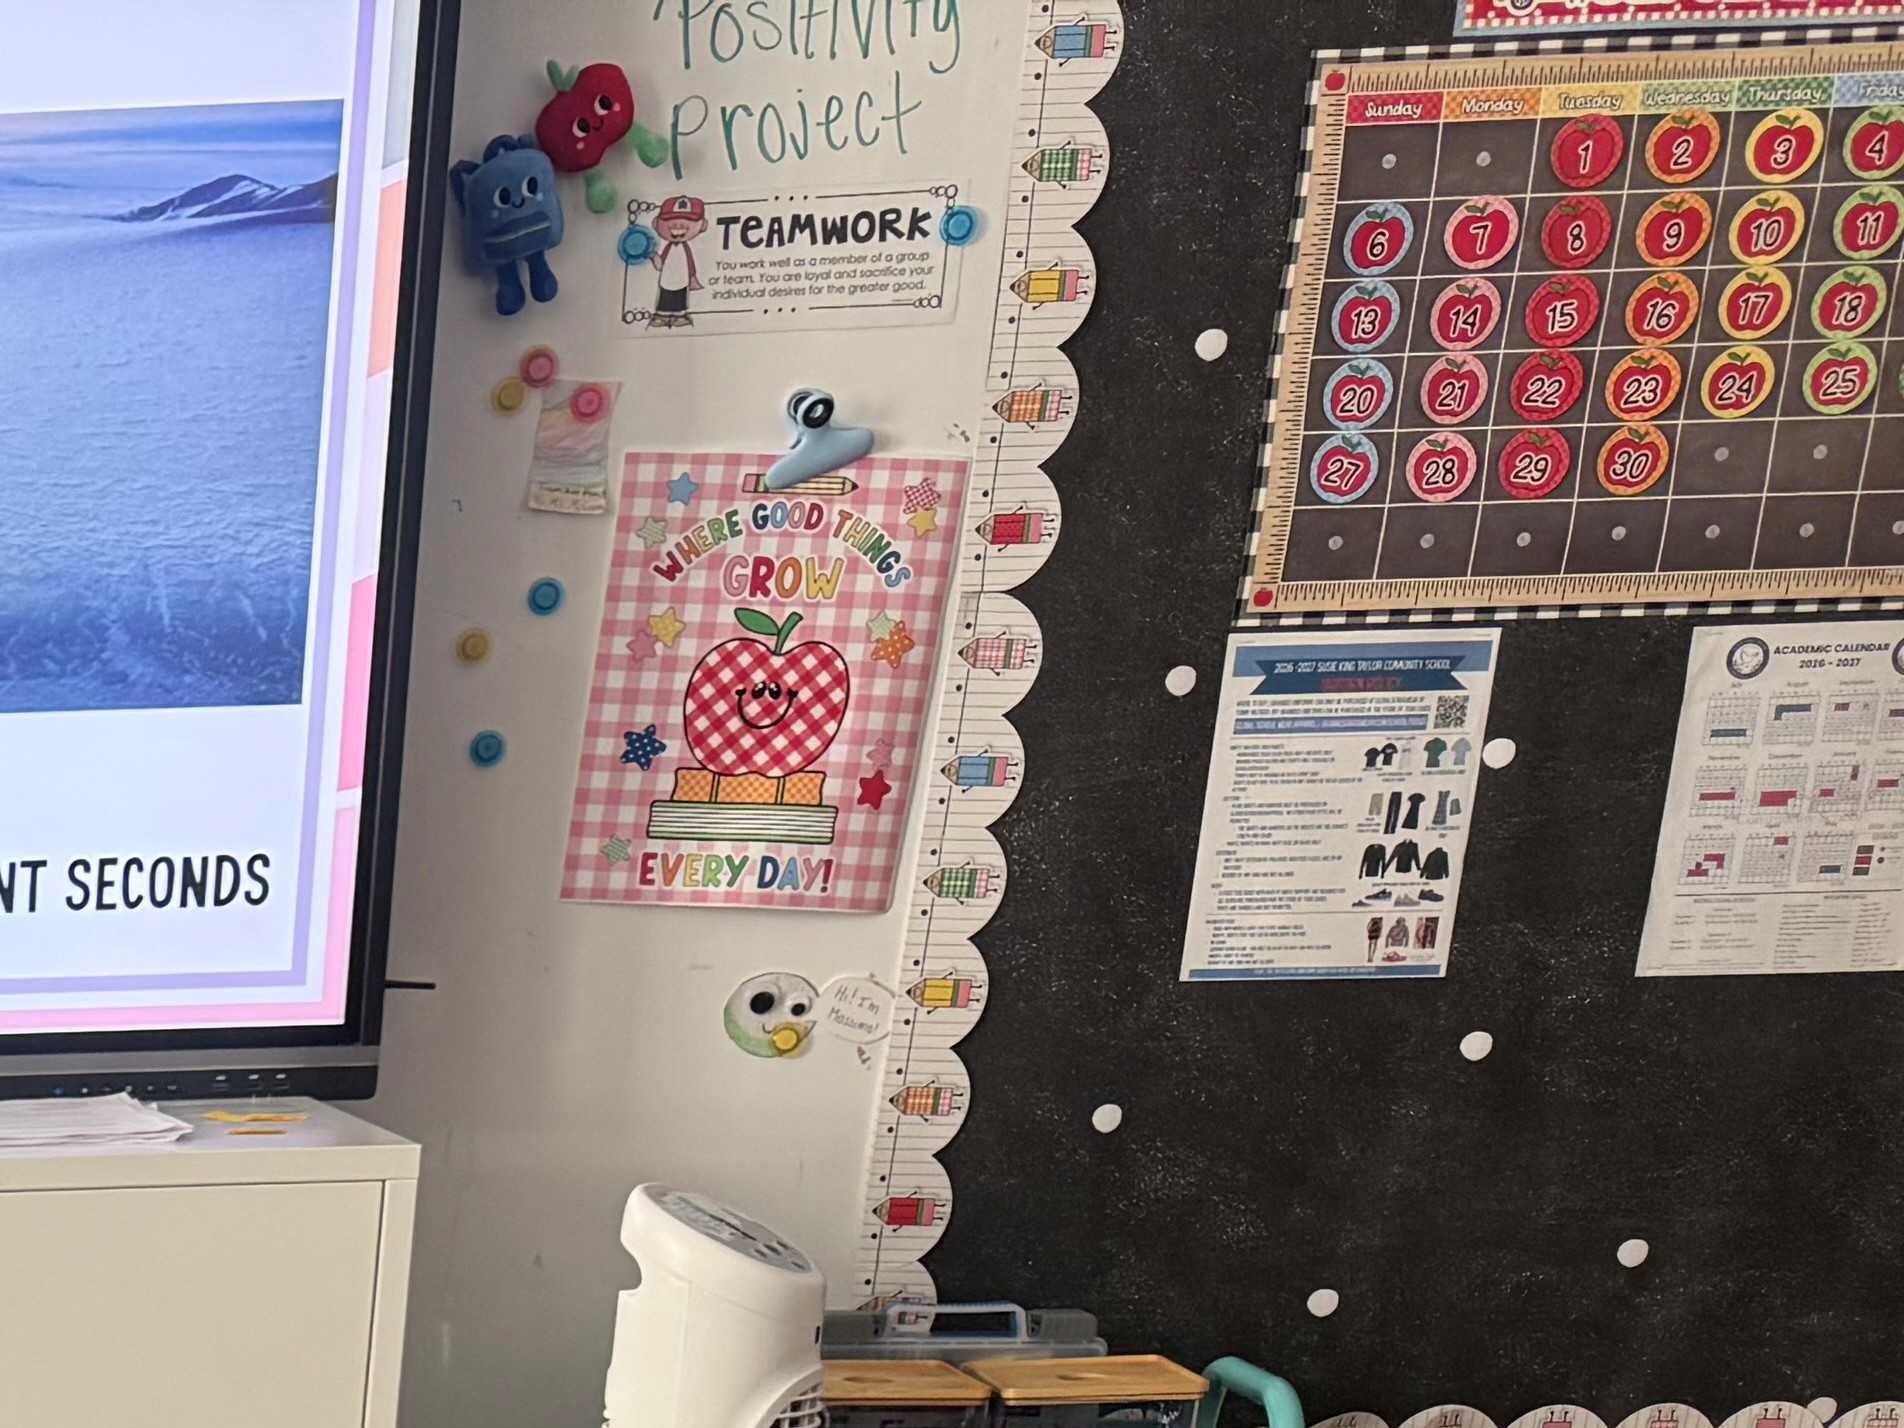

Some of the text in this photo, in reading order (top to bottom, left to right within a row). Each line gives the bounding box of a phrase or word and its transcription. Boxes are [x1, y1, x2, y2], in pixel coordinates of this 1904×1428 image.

[1365, 101, 1423, 123] Sunday
[1462, 97, 1525, 115] Monday
[1558, 92, 1623, 109] Tuesday
[1644, 88, 1731, 106] Wednesday
[1748, 84, 1823, 102] Thursday
[1579, 132, 1888, 173] 1 2 3 4
[1369, 213, 1884, 258] 6 7 8 9 10 11
[715, 251, 930, 272] You work well as a member of a group
[759, 272, 780, 284] You
[782, 271, 802, 282] are
[804, 268, 832, 283] loyal
[834, 267, 857, 280] and
[859, 265, 906, 279] sacrifice
[909, 265, 935, 279] your
[712, 286, 766, 300] individual
[768, 284, 806, 298] desires
[808, 283, 825, 296] for
[827, 282, 845, 295] the
[848, 281, 890, 296] greater
[1351, 294, 1863, 338] 13 14 15 16 17 18
[1339, 366, 1858, 415] 20 21 22 23 24 25
[1322, 451, 1650, 488] 27 28 29 30
[652, 501, 912, 589] WHERE GOOD THINGS
[722, 554, 844, 599] GROW
[1773, 642, 1891, 655] ACADEMIC CALENDAR
[65, 853, 271, 912] SECONDS
[639, 850, 834, 893] EVERY DAY!
